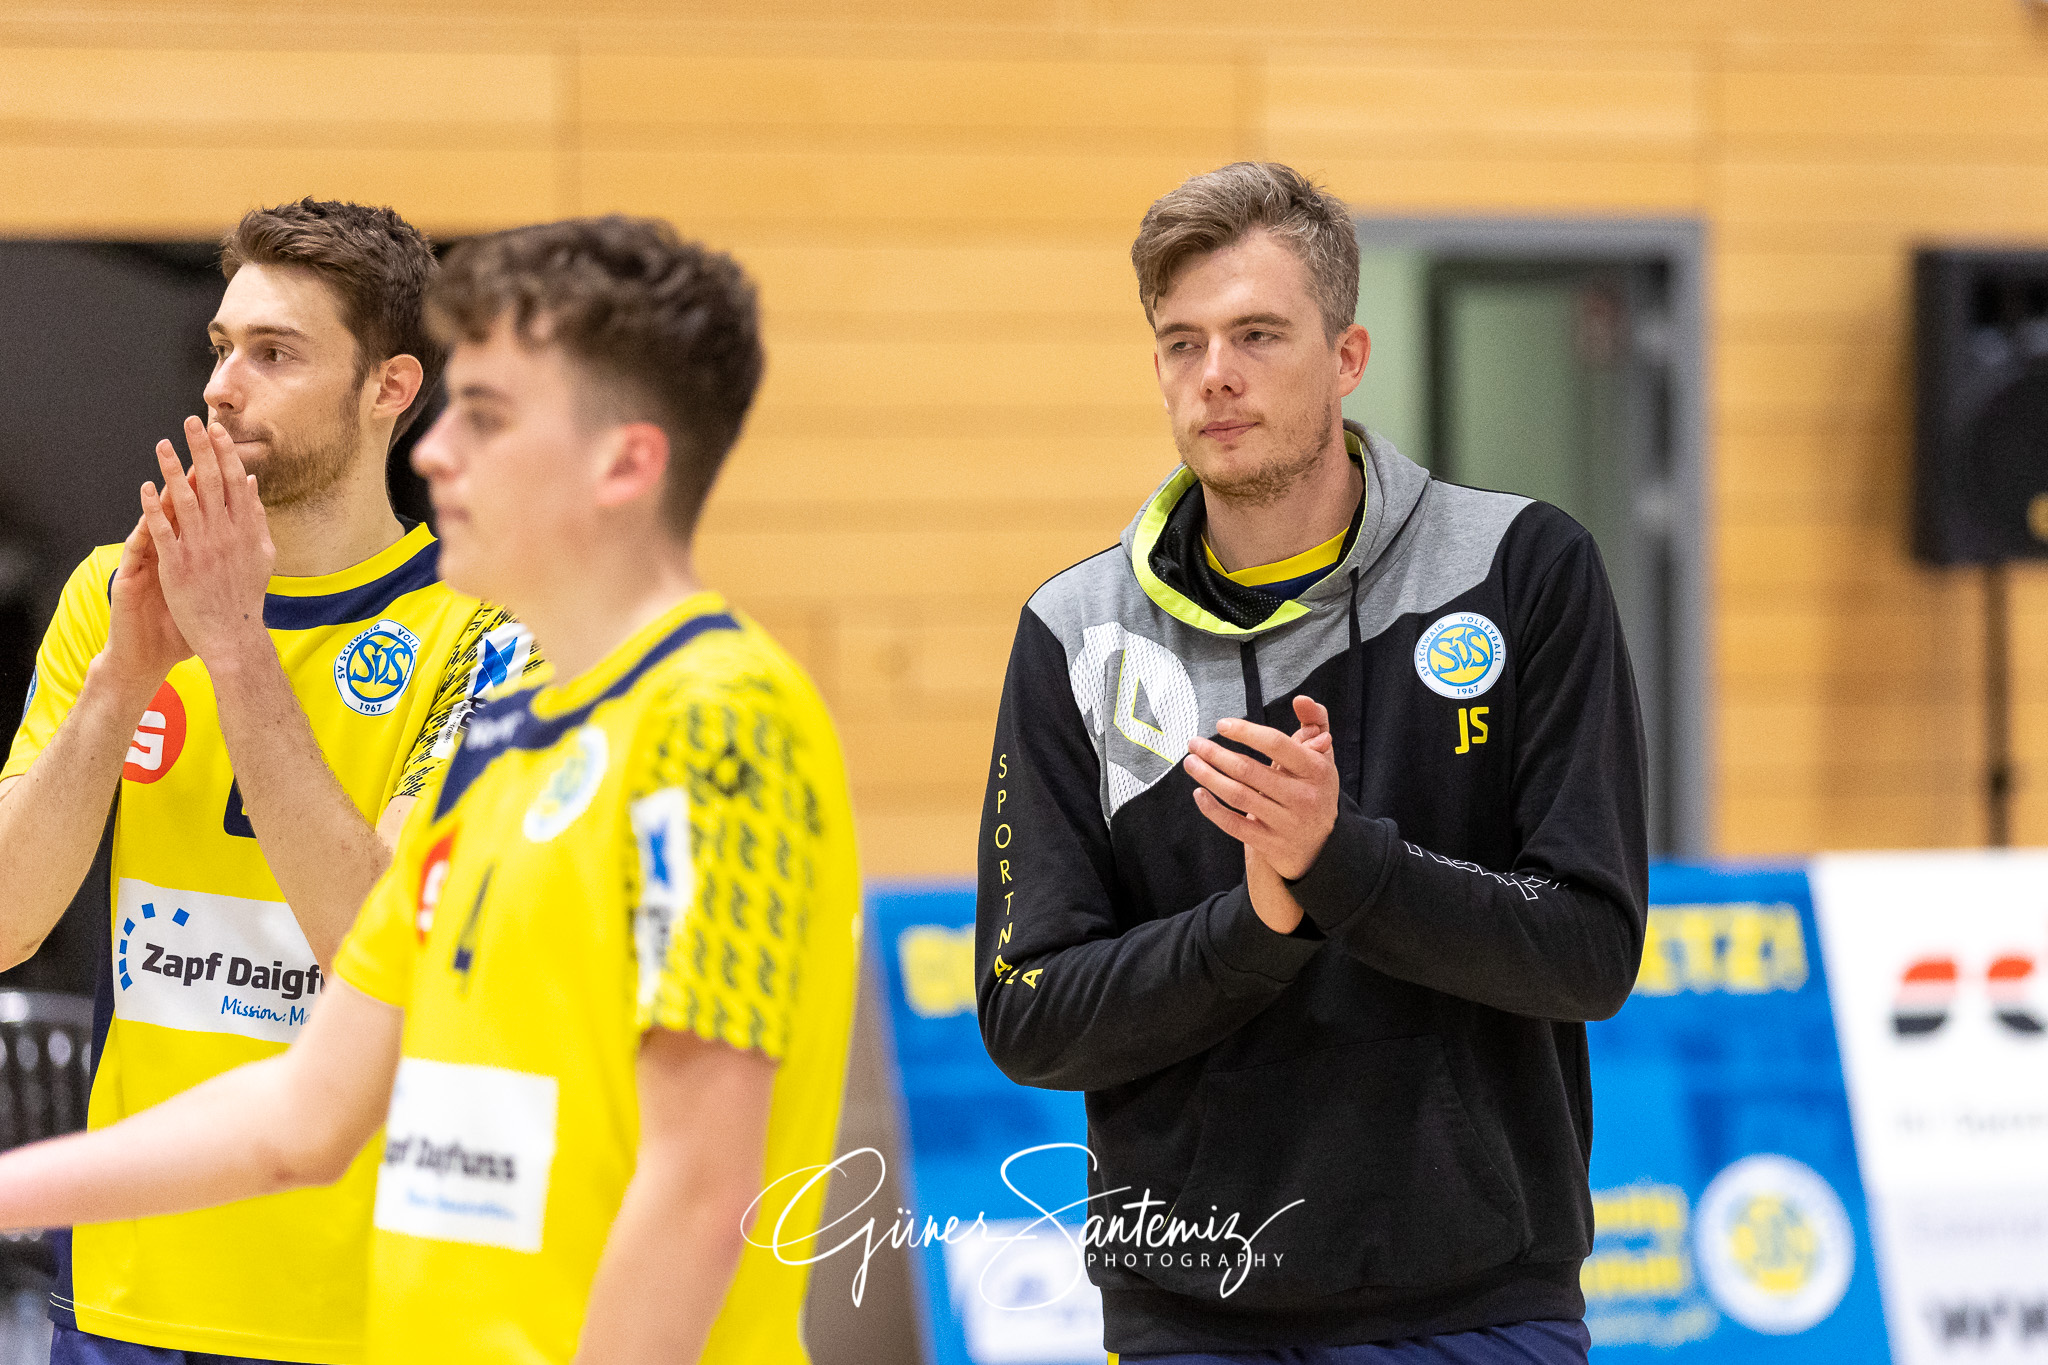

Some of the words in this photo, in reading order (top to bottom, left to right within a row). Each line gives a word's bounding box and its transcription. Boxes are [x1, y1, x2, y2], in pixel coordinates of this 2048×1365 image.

[340, 624, 381, 662] SCHWAIG
[1418, 622, 1445, 662] SCHWAIG
[1460, 616, 1502, 662] VOLLEYBALL
[1420, 665, 1431, 678] SV
[1456, 684, 1479, 695] 1967
[359, 702, 383, 713] 1967
[1455, 706, 1490, 755] JS
[141, 942, 223, 987] Zapf
[221, 995, 287, 1022] Mission:
